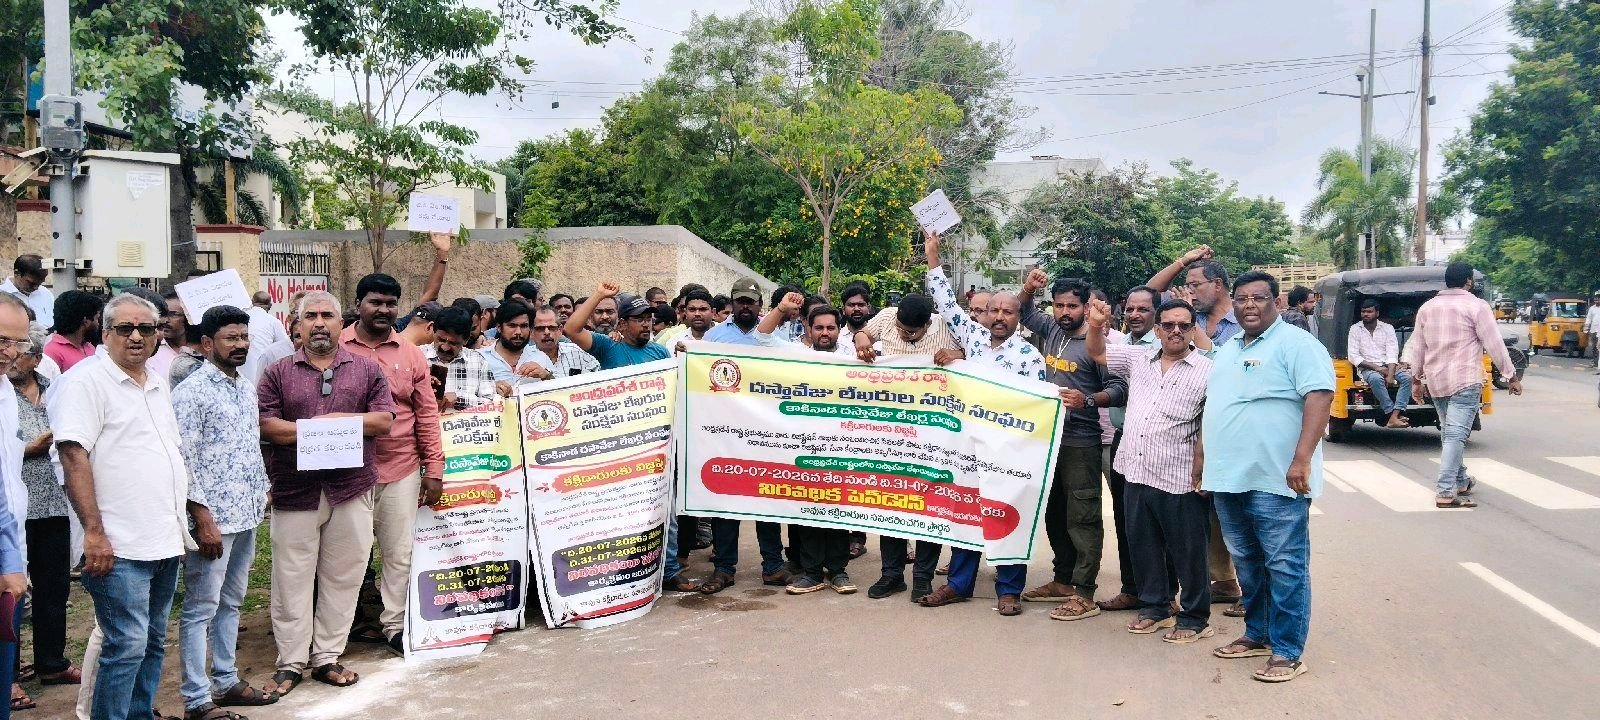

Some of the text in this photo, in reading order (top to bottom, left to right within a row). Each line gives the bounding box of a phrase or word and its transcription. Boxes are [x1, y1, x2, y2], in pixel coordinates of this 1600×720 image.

[268, 278, 283, 304] No
[572, 400, 622, 418] దస్తావేజు
[627, 405, 667, 422] సంఘం
[750, 382, 833, 400] దస్తావేజు
[968, 404, 1036, 432] సంఘం
[785, 404, 838, 416] కాకినాడ
[840, 406, 894, 420] దస్తావేజు
[443, 416, 492, 432] దస్తావేజు
[540, 447, 580, 462] కాకినాడ
[580, 440, 618, 454] దస్తావేజు
